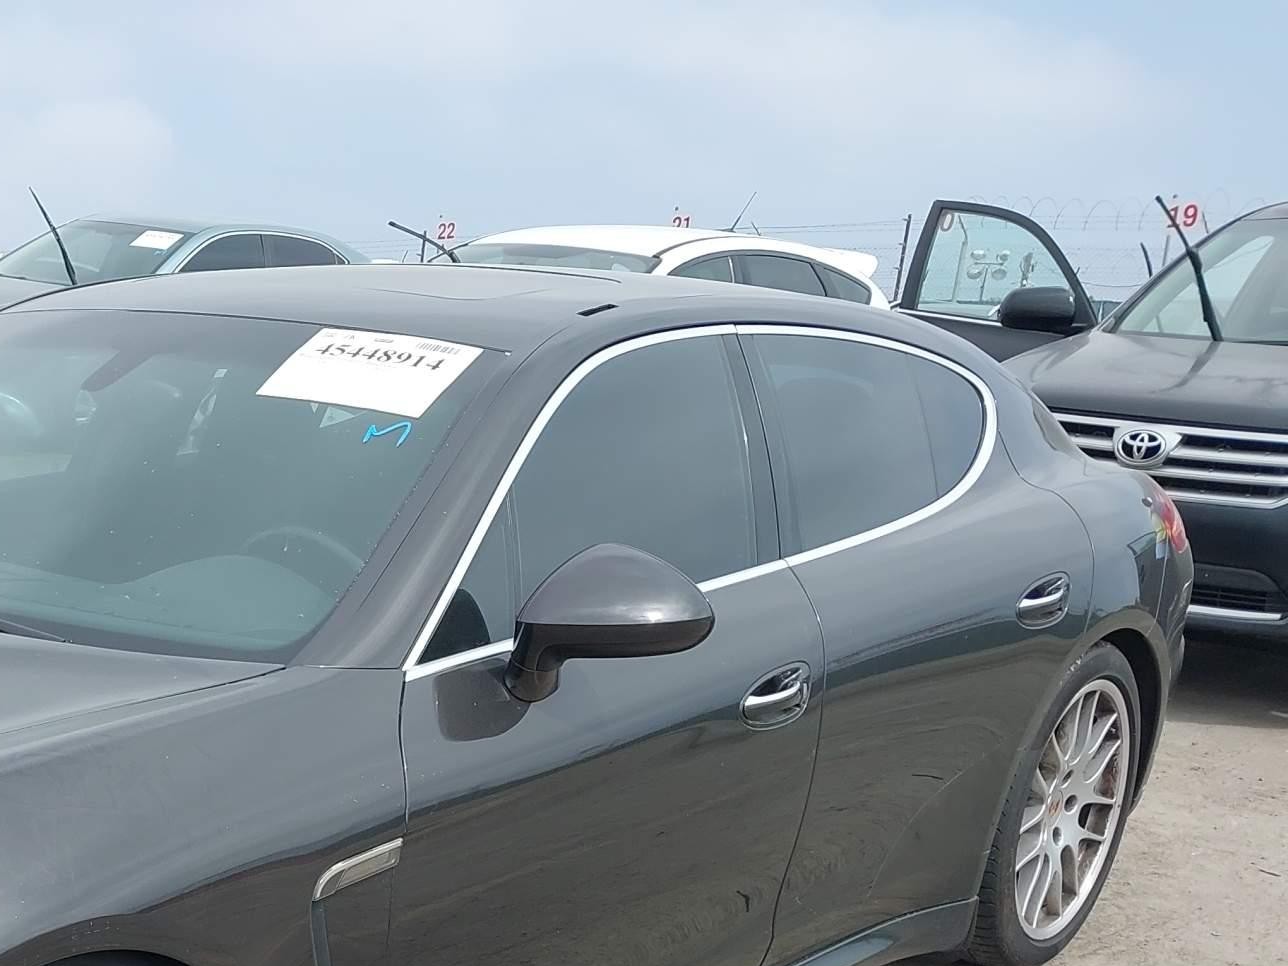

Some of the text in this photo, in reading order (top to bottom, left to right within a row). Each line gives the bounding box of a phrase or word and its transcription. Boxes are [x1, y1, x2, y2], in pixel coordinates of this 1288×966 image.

[672, 216, 691, 228] 21
[1167, 204, 1198, 228] 19
[437, 222, 456, 240] 22
[316, 343, 446, 371] 45448914
